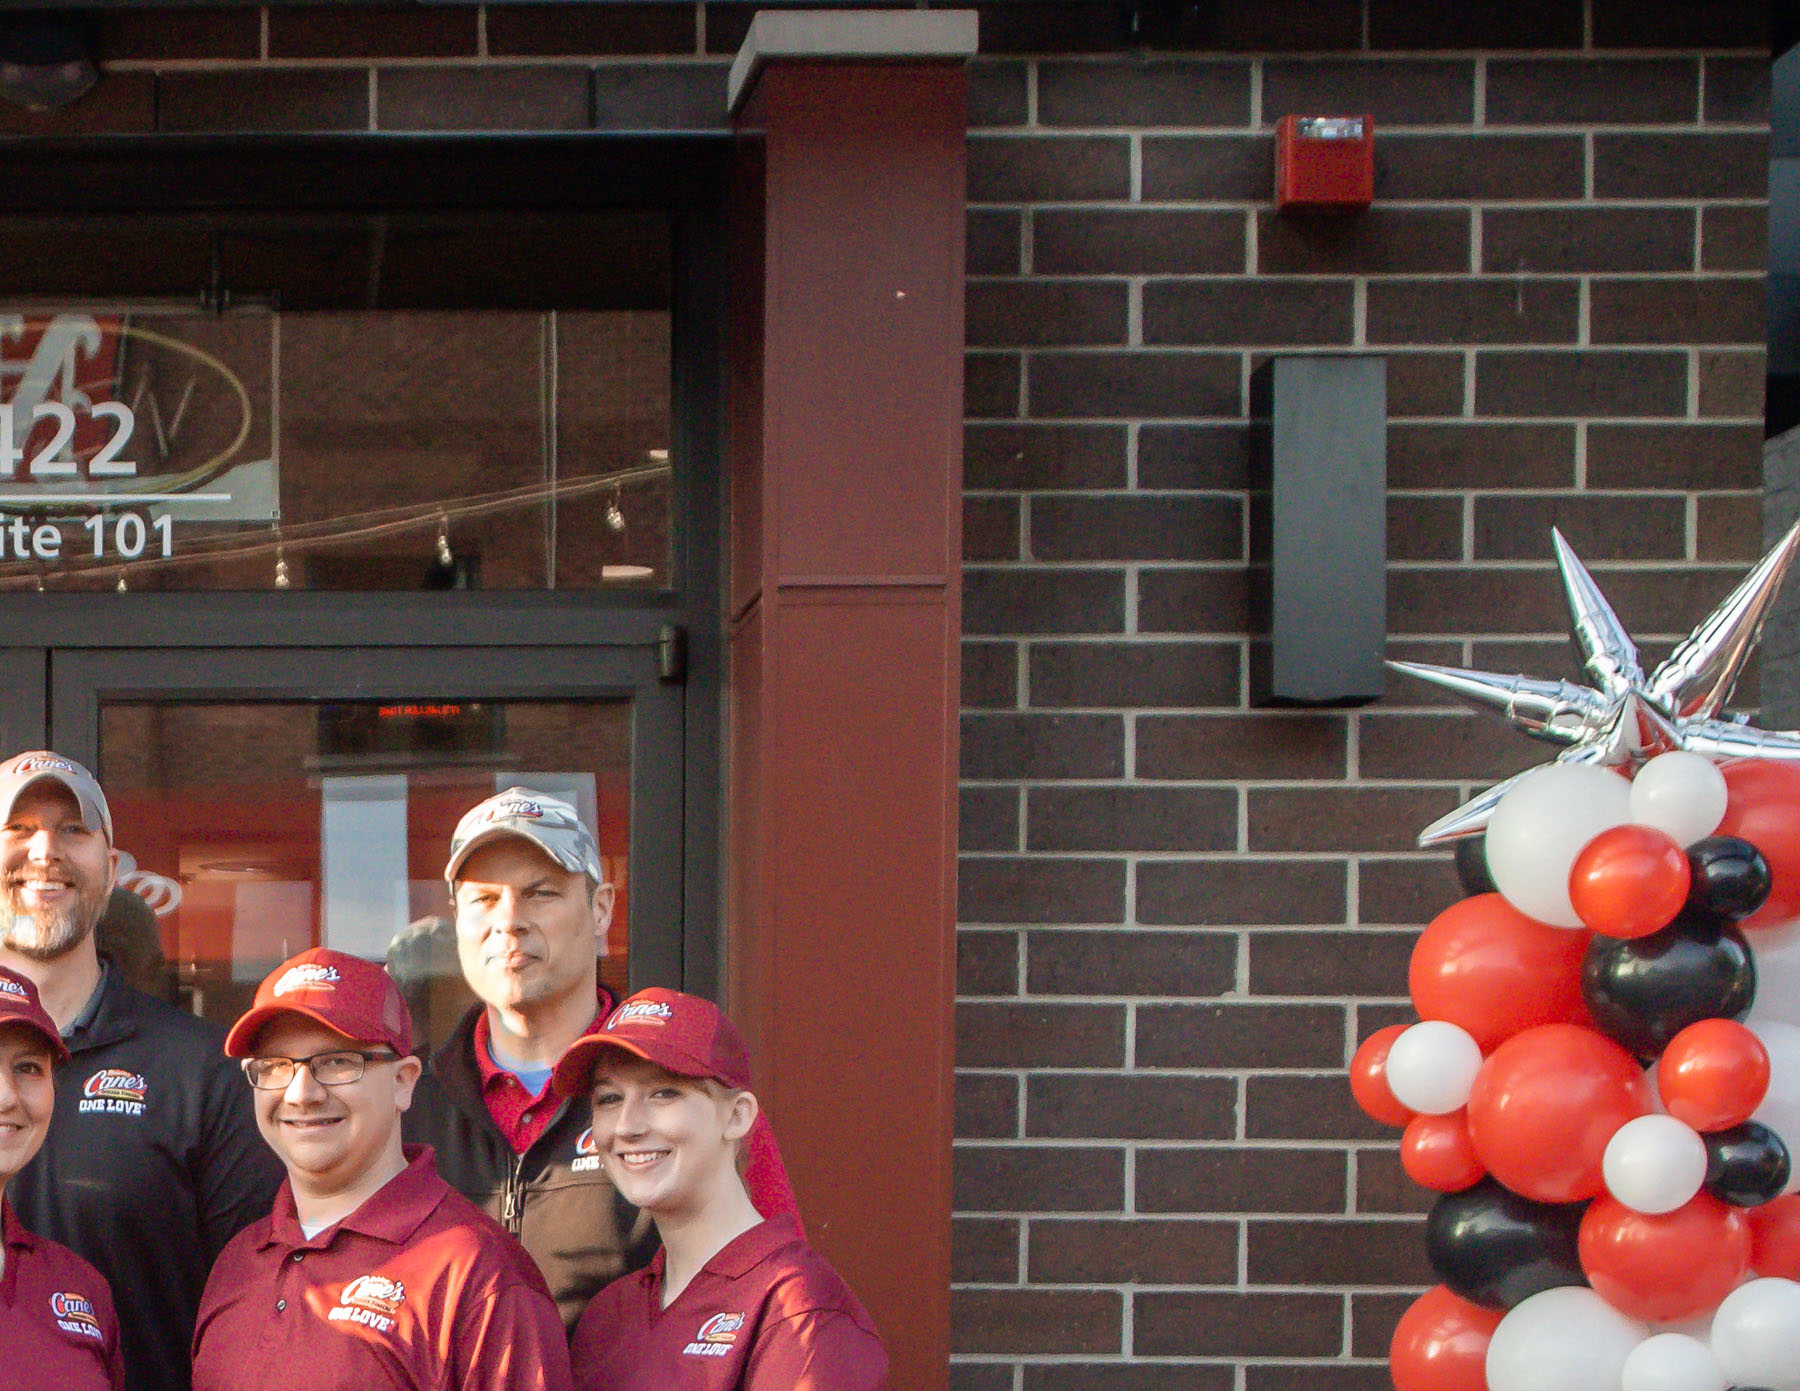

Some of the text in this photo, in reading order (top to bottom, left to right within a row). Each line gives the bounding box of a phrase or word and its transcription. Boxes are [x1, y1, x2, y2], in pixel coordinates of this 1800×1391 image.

[83, 516, 177, 559] 101
[607, 1002, 672, 1031] Cane's
[84, 1069, 147, 1099] Cane's
[79, 1099, 142, 1116] ONE LOVE
[351, 1307, 391, 1332] LOVE
